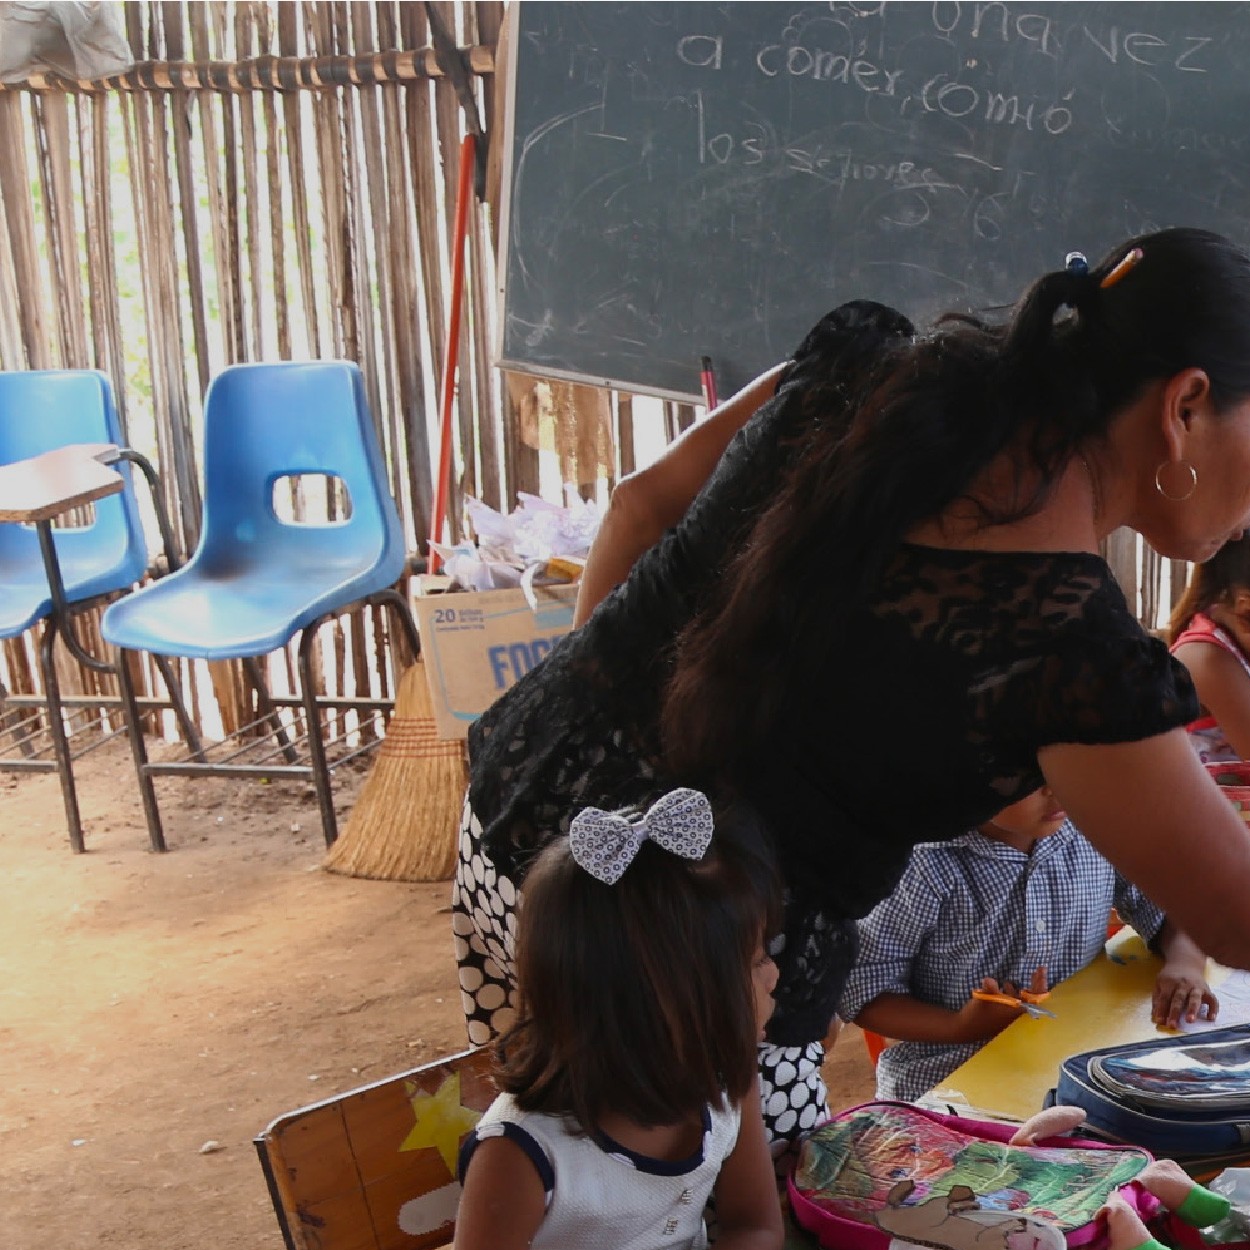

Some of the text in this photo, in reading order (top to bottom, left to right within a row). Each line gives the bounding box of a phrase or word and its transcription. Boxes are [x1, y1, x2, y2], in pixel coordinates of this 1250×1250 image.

[677, 34, 723, 70] a
[1083, 27, 1213, 73] vez
[697, 88, 764, 165] los
[435, 608, 457, 623] 20
[488, 636, 561, 690] FOC
